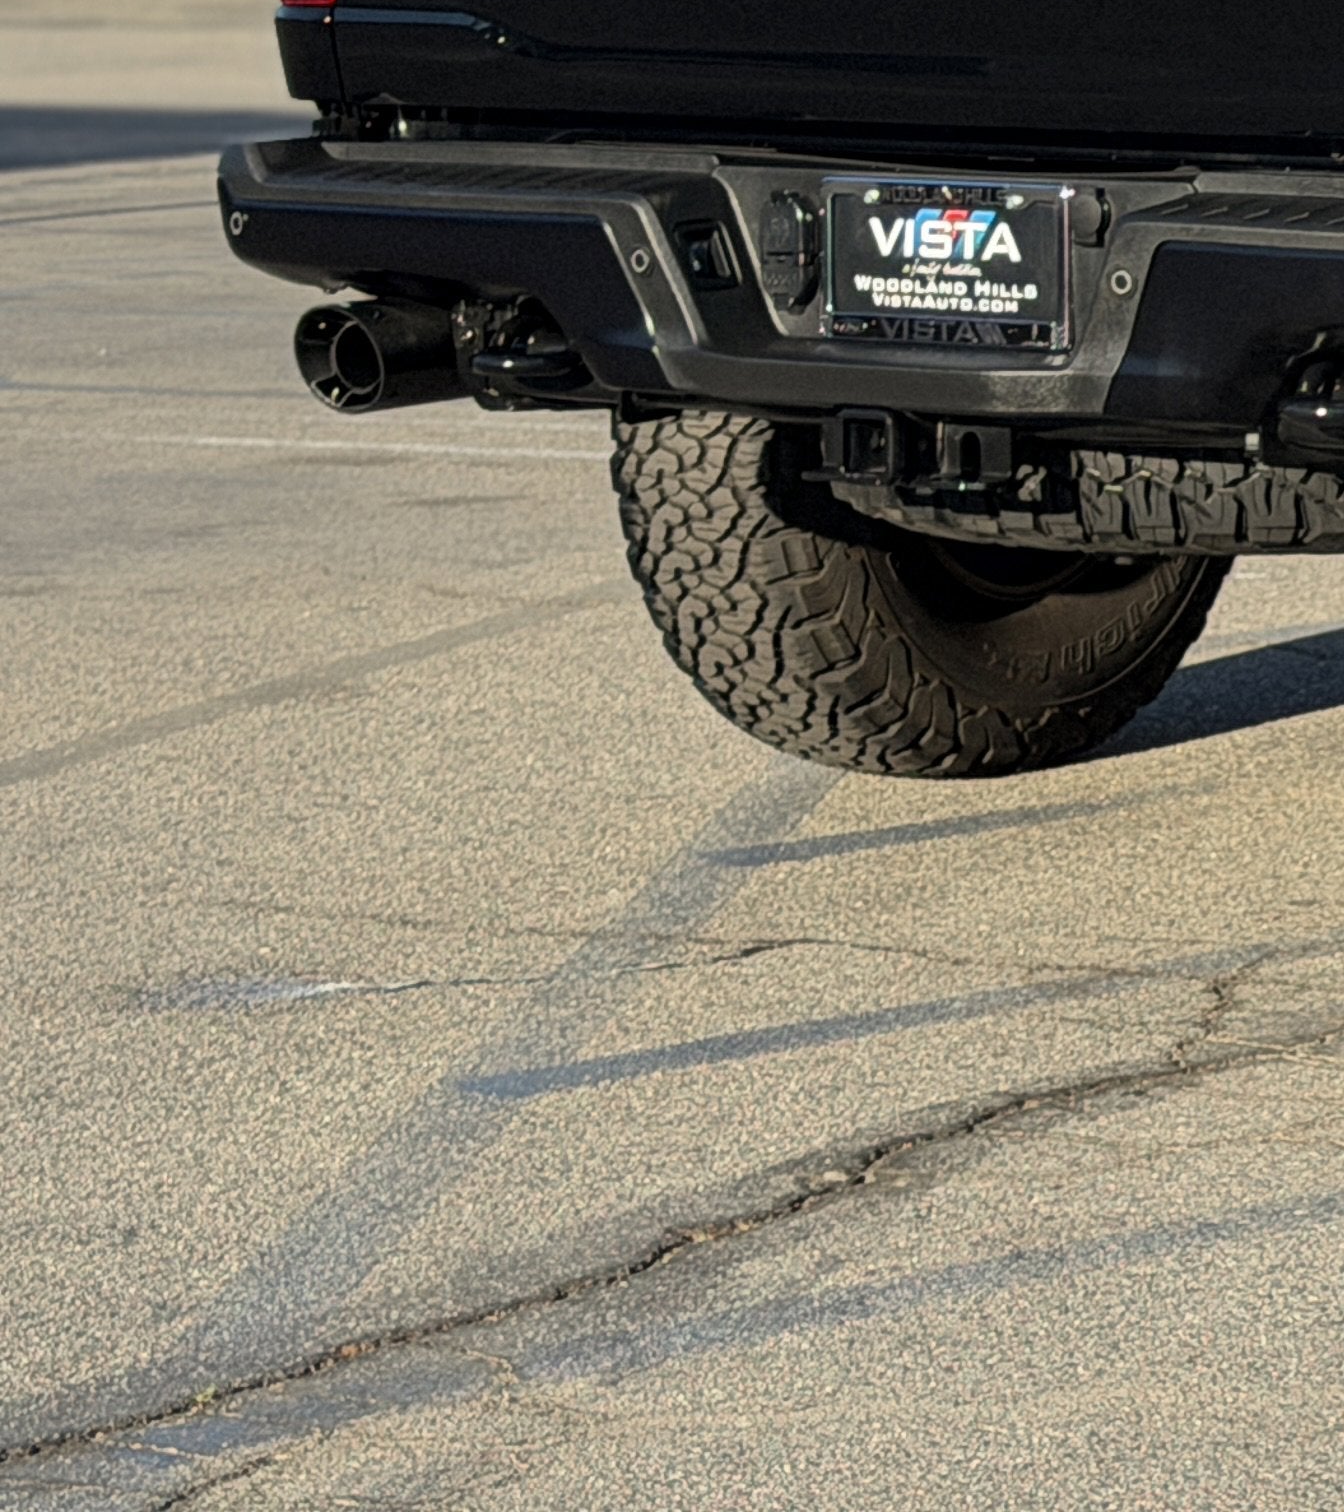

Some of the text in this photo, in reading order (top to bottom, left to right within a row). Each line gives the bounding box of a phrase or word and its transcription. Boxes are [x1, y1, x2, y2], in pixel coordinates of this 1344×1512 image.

[868, 216, 1023, 263] VISTA
[853, 273, 1039, 301] WOODLAND HILLS
[877, 317, 980, 345] VISTA
